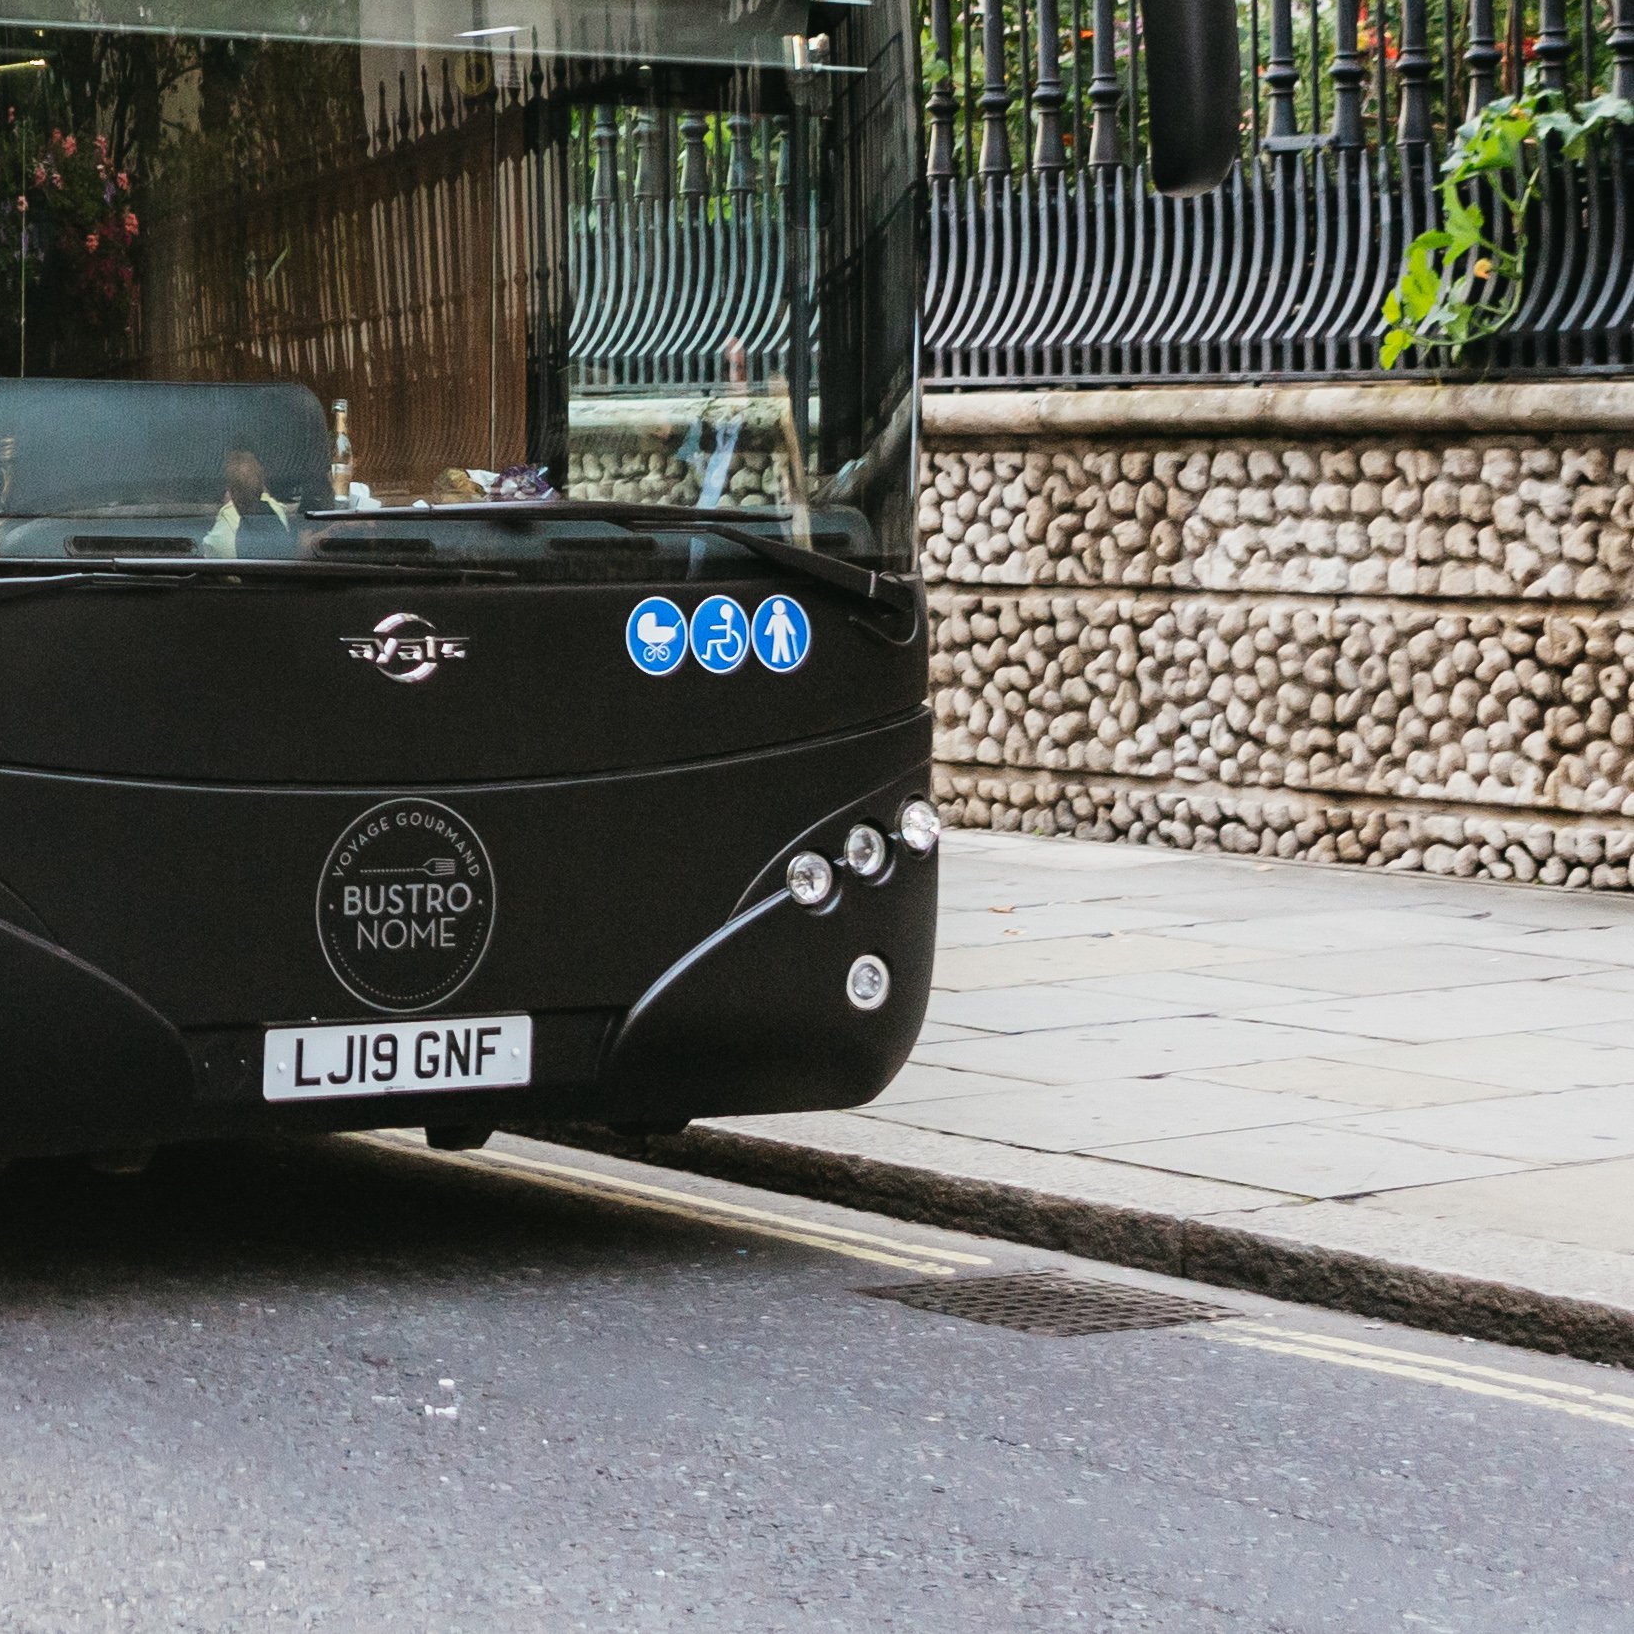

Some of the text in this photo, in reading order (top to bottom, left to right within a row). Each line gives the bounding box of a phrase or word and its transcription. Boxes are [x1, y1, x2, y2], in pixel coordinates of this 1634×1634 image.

[332, 812, 480, 877] VOYAGE GOURMAND
[343, 882, 472, 916] BUSTRO
[357, 917, 456, 950] NOME
[294, 1026, 502, 1087] LJ19 GNF
